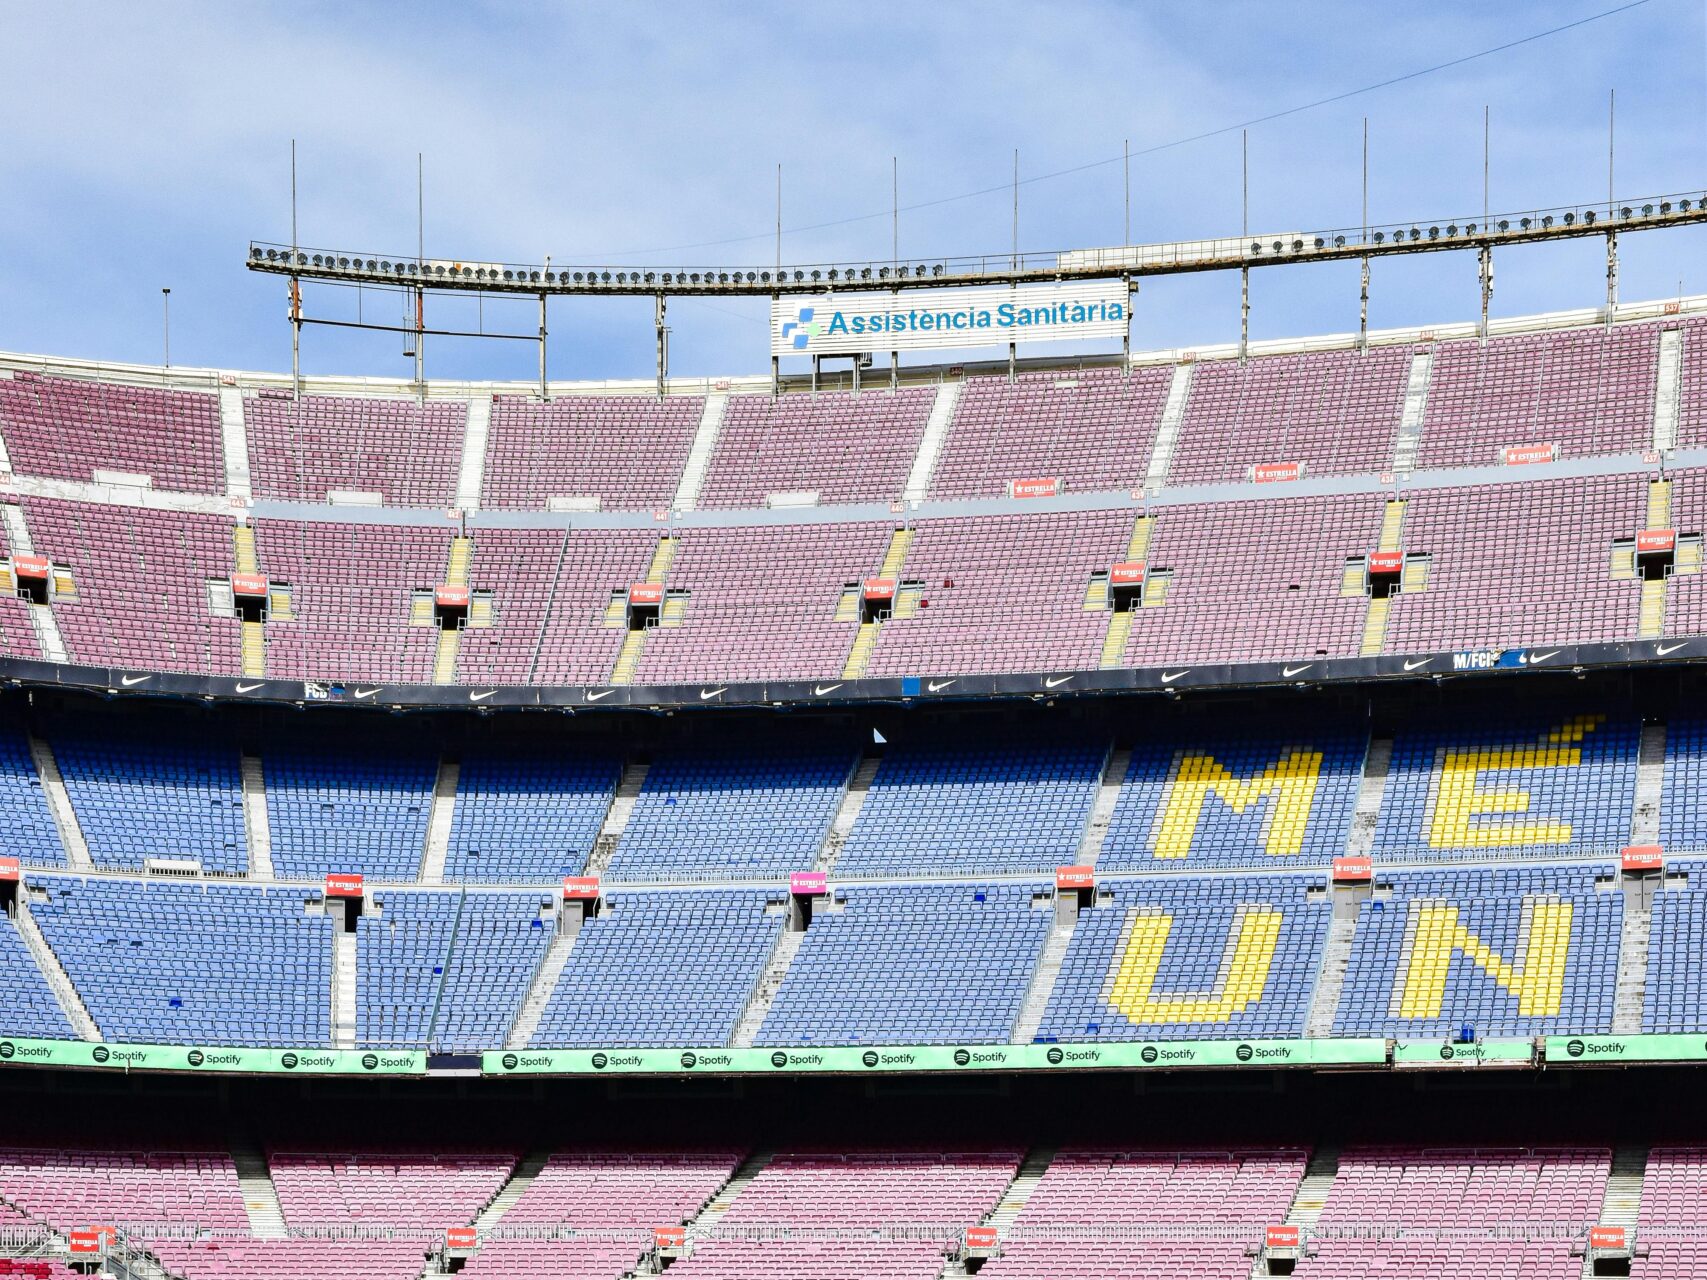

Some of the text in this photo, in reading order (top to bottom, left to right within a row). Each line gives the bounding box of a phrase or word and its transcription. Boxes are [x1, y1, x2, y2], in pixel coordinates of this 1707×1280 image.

[828, 299, 1123, 335] Assistència Sanitària
[1518, 451, 1550, 460] ESTRELLA
[1643, 454, 1658, 463] 437
[1266, 469, 1297, 478] ESTRELLA
[1024, 485, 1055, 493] ESTRELLA
[891, 504, 904, 513] 440
[655, 513, 667, 521] 441
[17, 1046, 52, 1058] Spotify
[1256, 1047, 1292, 1059] Spotify
[1587, 1043, 1626, 1055] Spotify
[112, 1050, 147, 1062] Spotify
[206, 1054, 242, 1066] Spotify
[698, 1055, 732, 1066] Spotify
[789, 1055, 823, 1066] Spotify
[881, 1054, 915, 1065] Spotify
[972, 1052, 1007, 1063] Spotify
[1066, 1051, 1100, 1062] Spotify
[1160, 1049, 1195, 1061] Spotify
[300, 1057, 335, 1068] Spotify
[380, 1057, 415, 1069] Spotify
[520, 1057, 553, 1068] Spotify
[609, 1056, 643, 1067] Spotify
